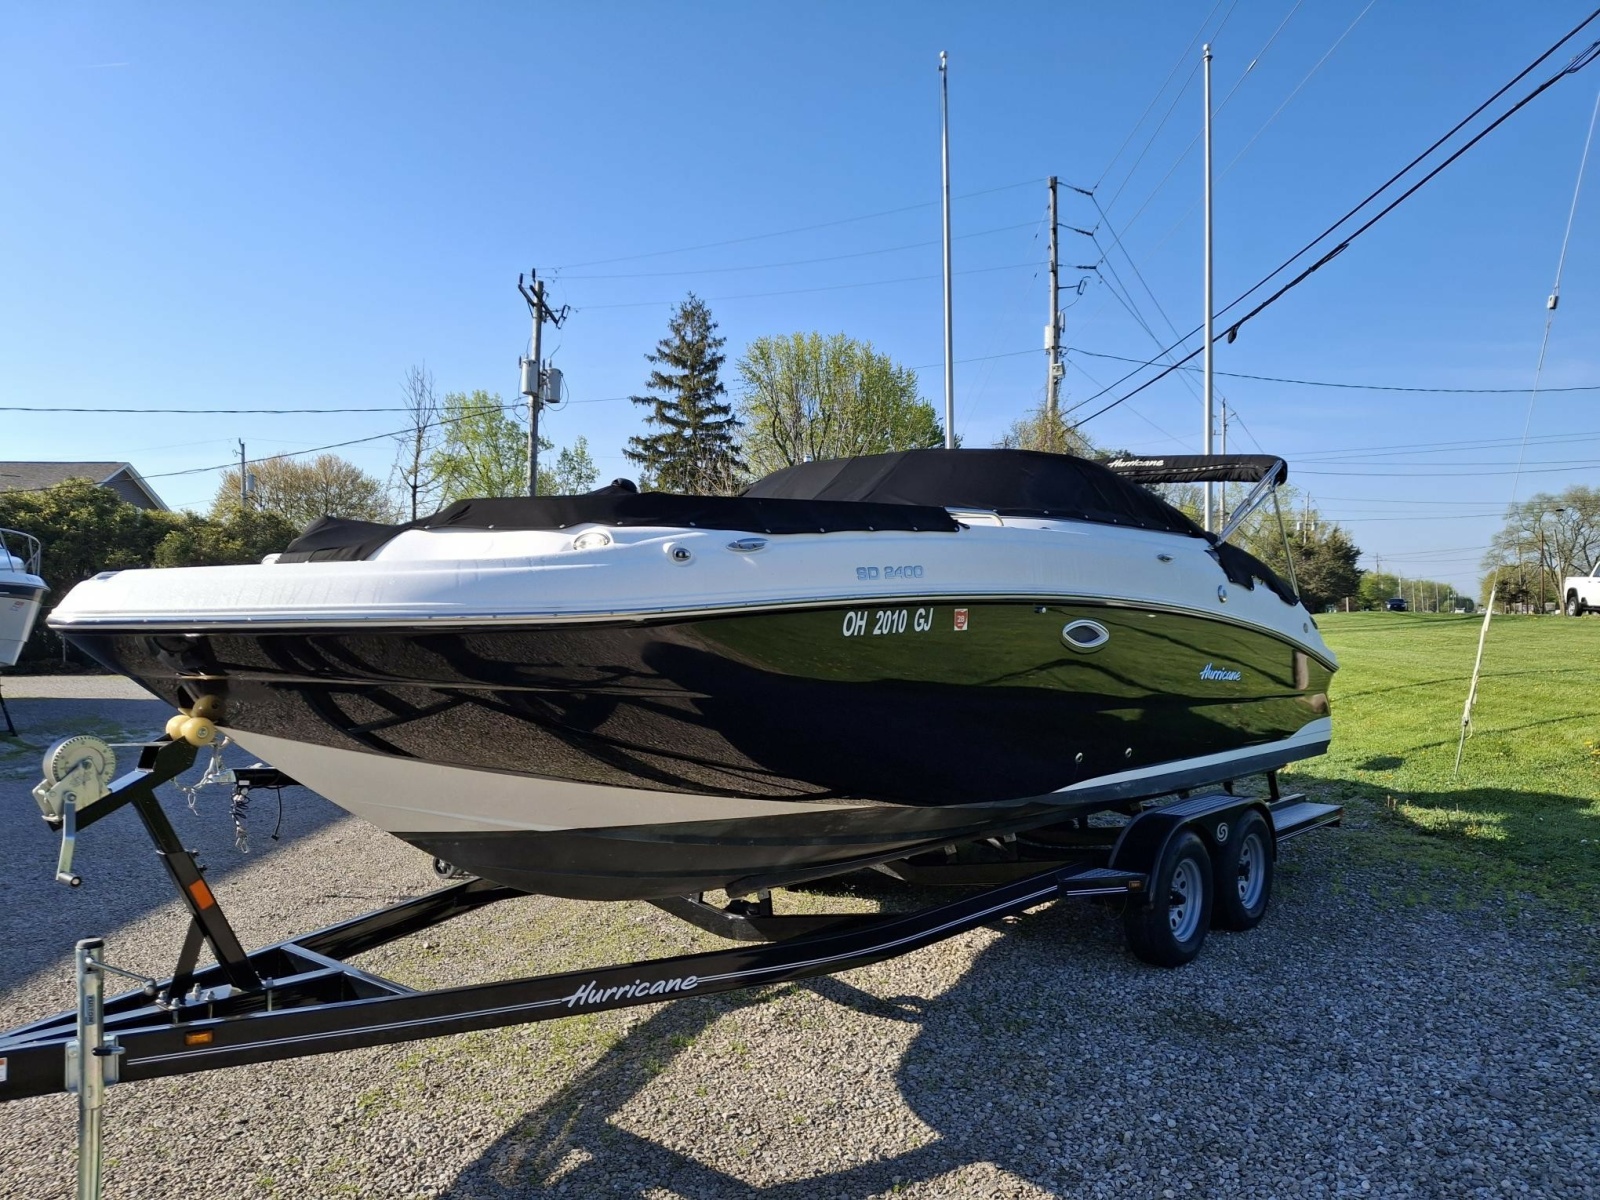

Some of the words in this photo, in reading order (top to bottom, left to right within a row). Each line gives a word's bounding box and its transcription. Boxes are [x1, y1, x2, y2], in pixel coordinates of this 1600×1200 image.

[1107, 458, 1164, 468] Hurricane
[856, 567, 880, 580] SD
[884, 565, 923, 579] 2400
[843, 611, 868, 637] OH
[873, 609, 908, 635] 2010
[914, 608, 934, 632] GJ
[1199, 663, 1241, 681] Hurricane
[562, 975, 698, 1008] Hurricane
